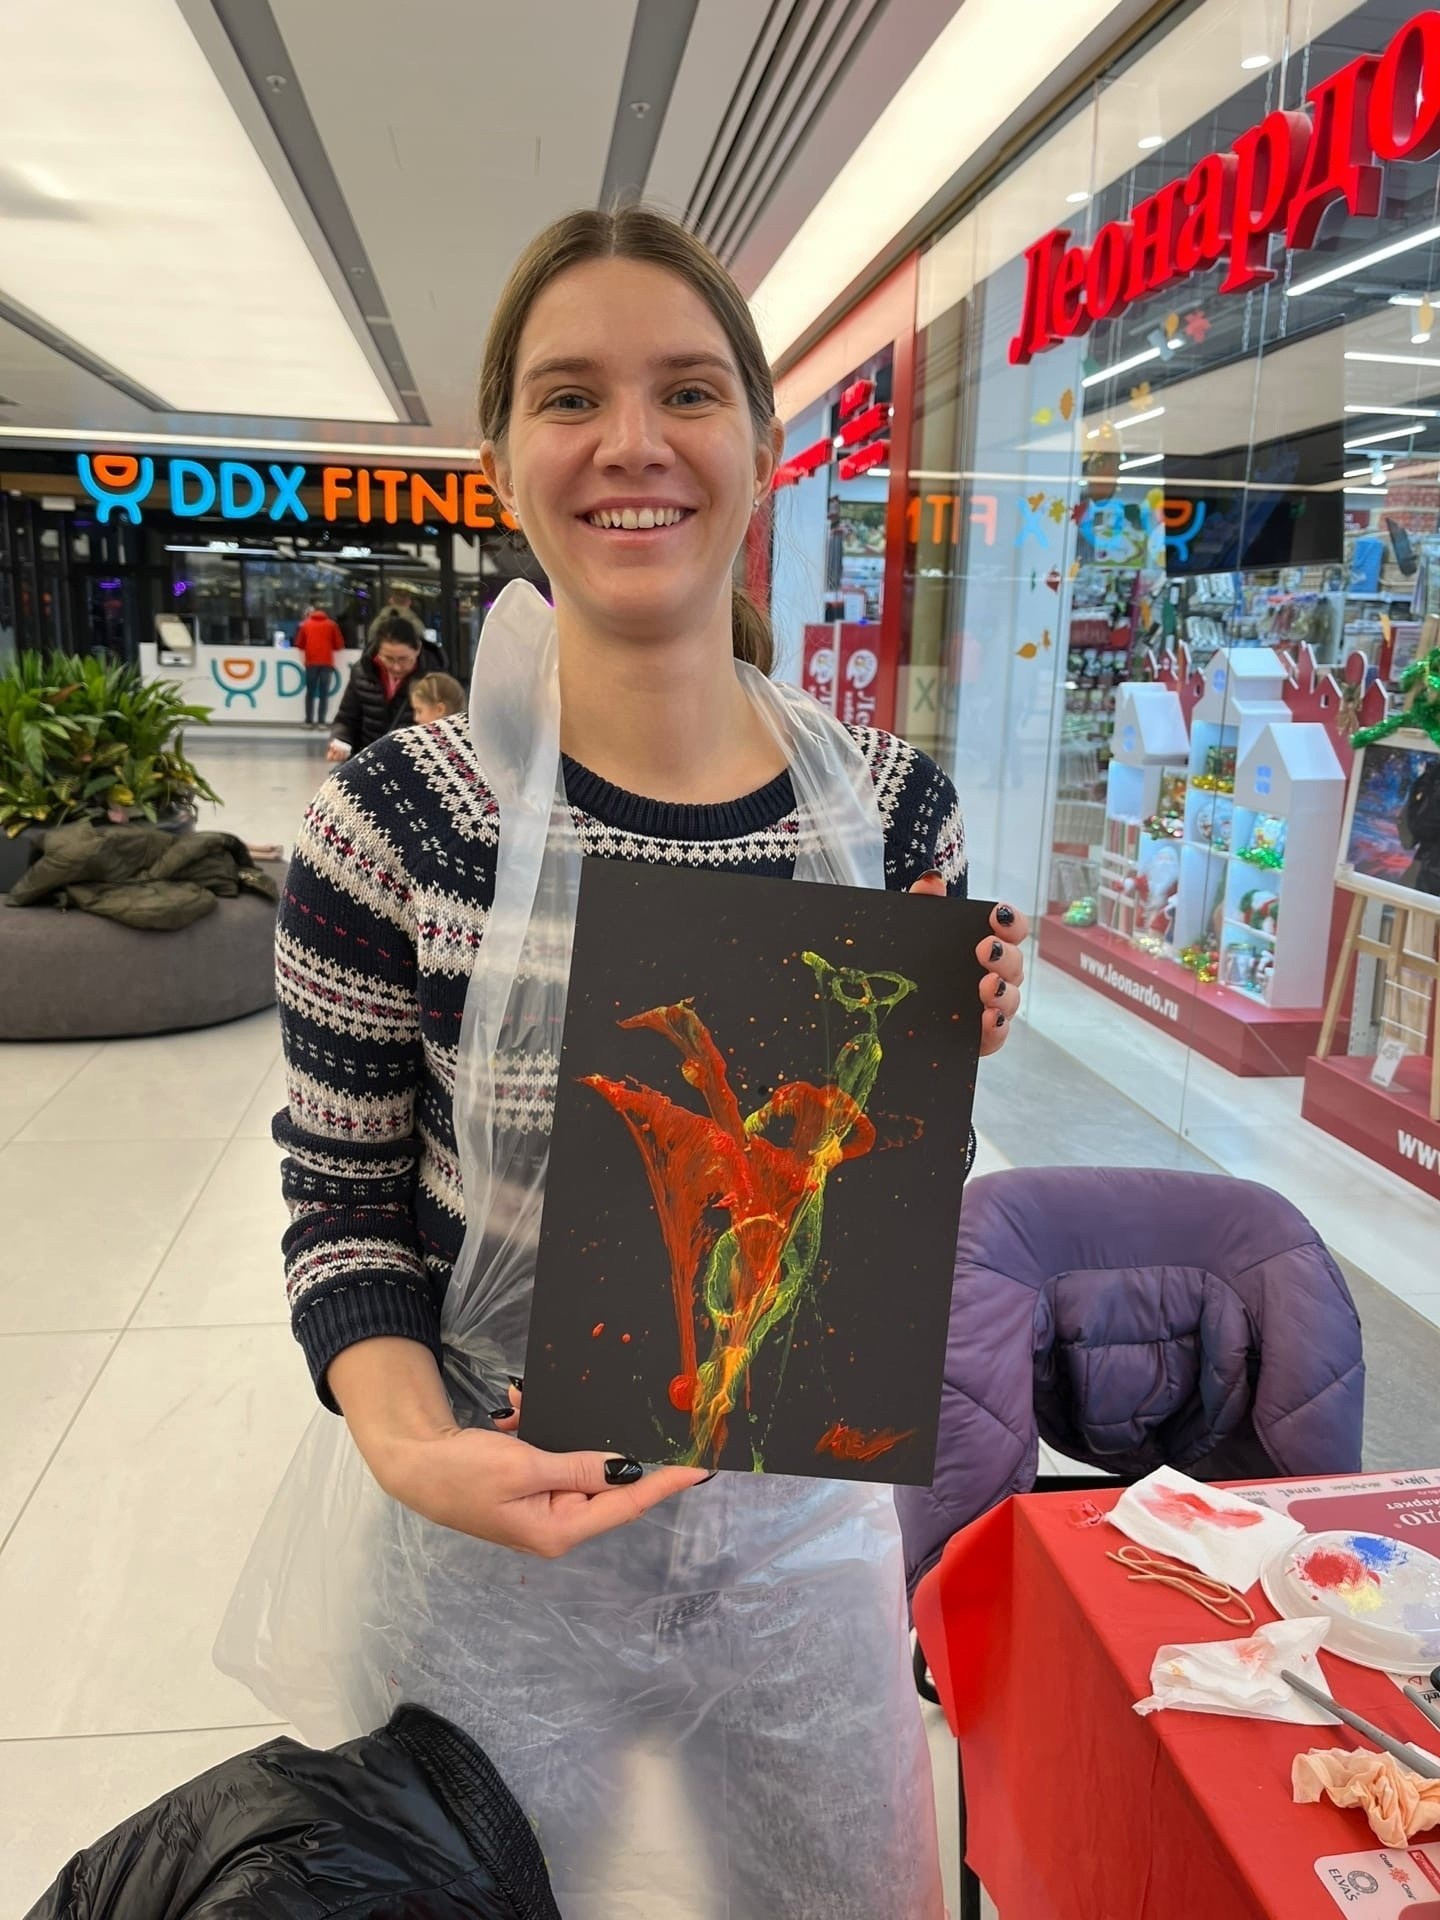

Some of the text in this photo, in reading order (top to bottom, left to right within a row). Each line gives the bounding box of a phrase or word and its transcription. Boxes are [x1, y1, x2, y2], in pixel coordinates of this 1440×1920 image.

[1008, 10, 1440, 365] Леонардо
[169, 459, 519, 531] DDX FITNE
[1080, 952, 1179, 1021] www.leonardo.ru
[1397, 1129, 1440, 1178] ww
[1400, 1508, 1440, 1526] до
